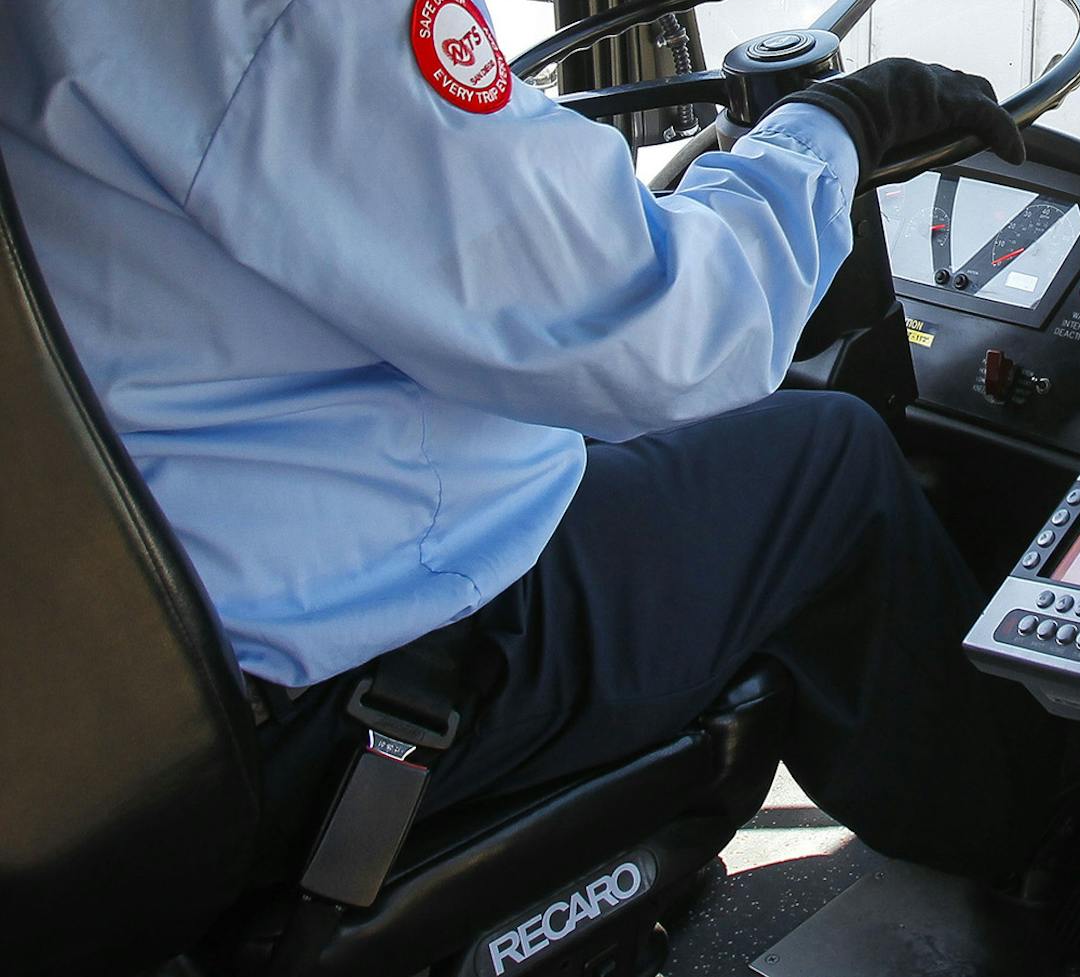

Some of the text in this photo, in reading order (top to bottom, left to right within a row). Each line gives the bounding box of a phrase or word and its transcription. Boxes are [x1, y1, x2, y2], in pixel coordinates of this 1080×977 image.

[420, 1, 436, 39] SAFE
[433, 68, 474, 102] EVERY
[476, 88, 499, 104] TRIP
[488, 862, 642, 976] RECARO
